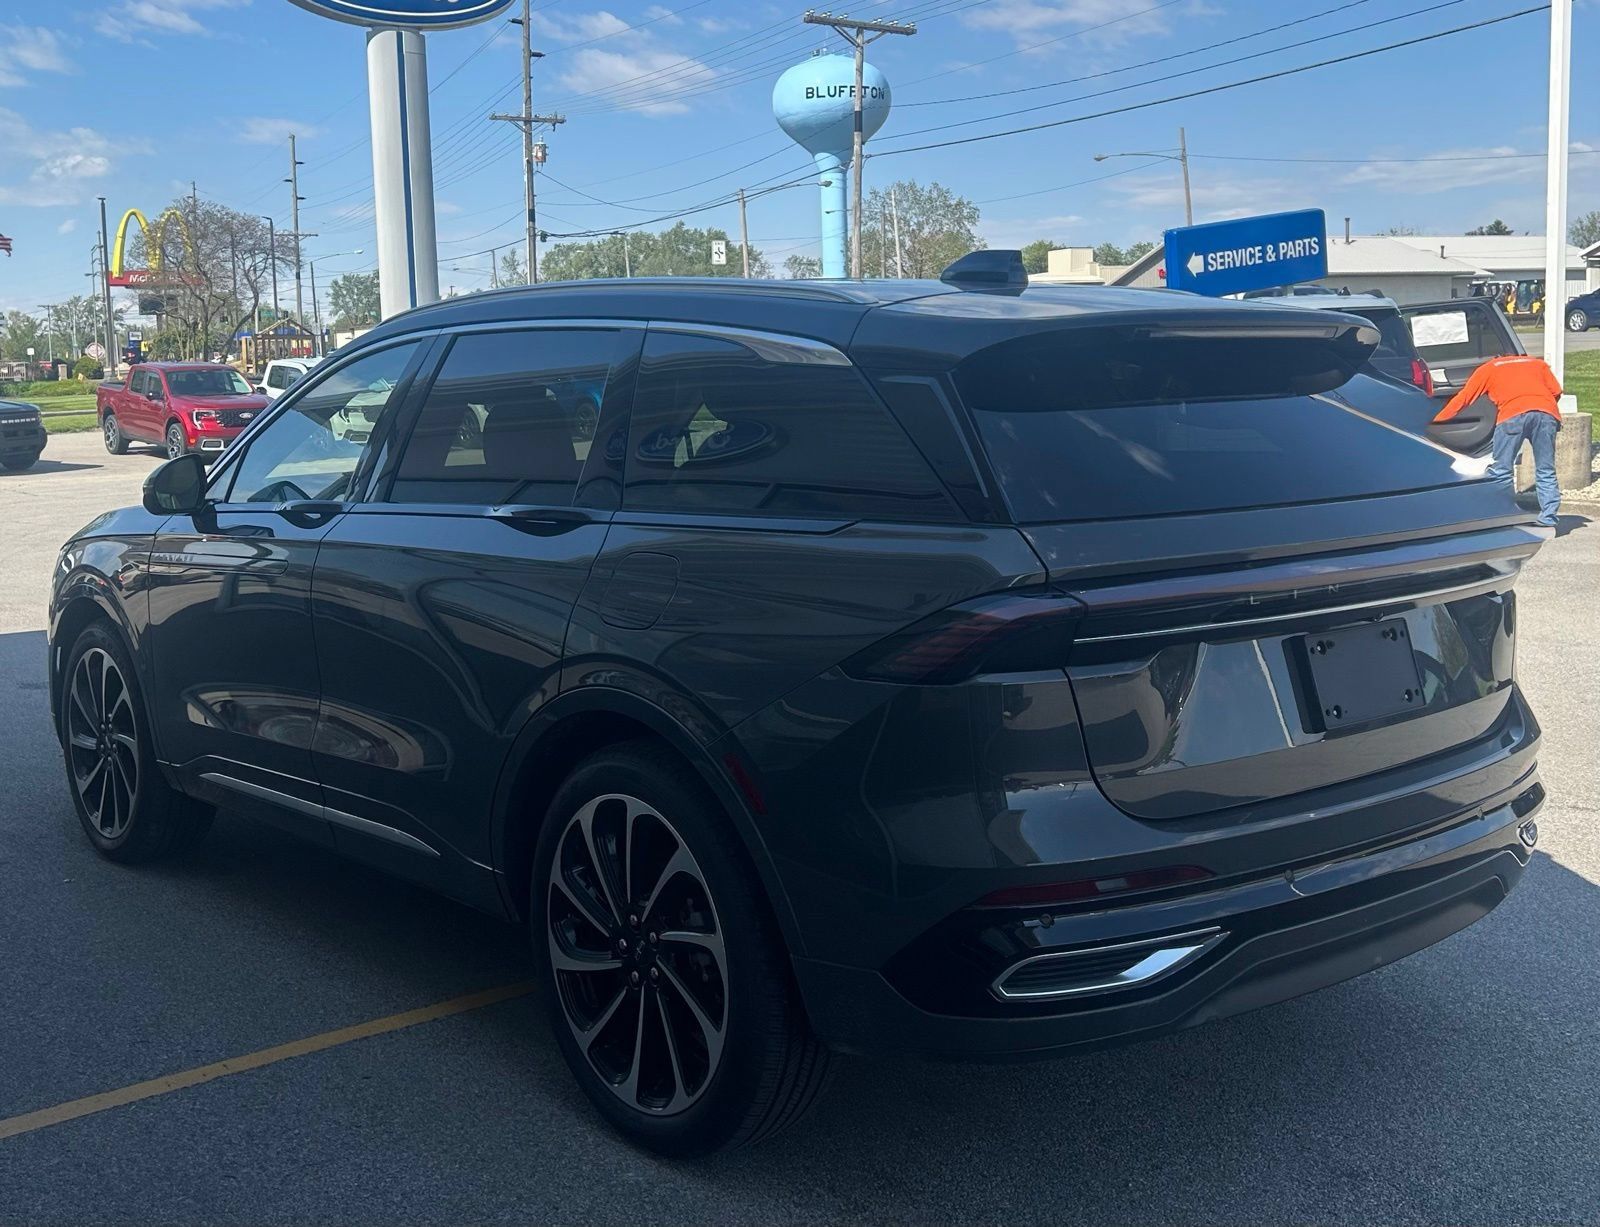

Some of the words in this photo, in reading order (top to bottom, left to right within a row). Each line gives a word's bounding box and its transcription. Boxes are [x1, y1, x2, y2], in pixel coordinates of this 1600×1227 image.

[1207, 245, 1263, 272] SERVICE
[1266, 244, 1276, 262] &
[1279, 236, 1320, 261] PARTS
